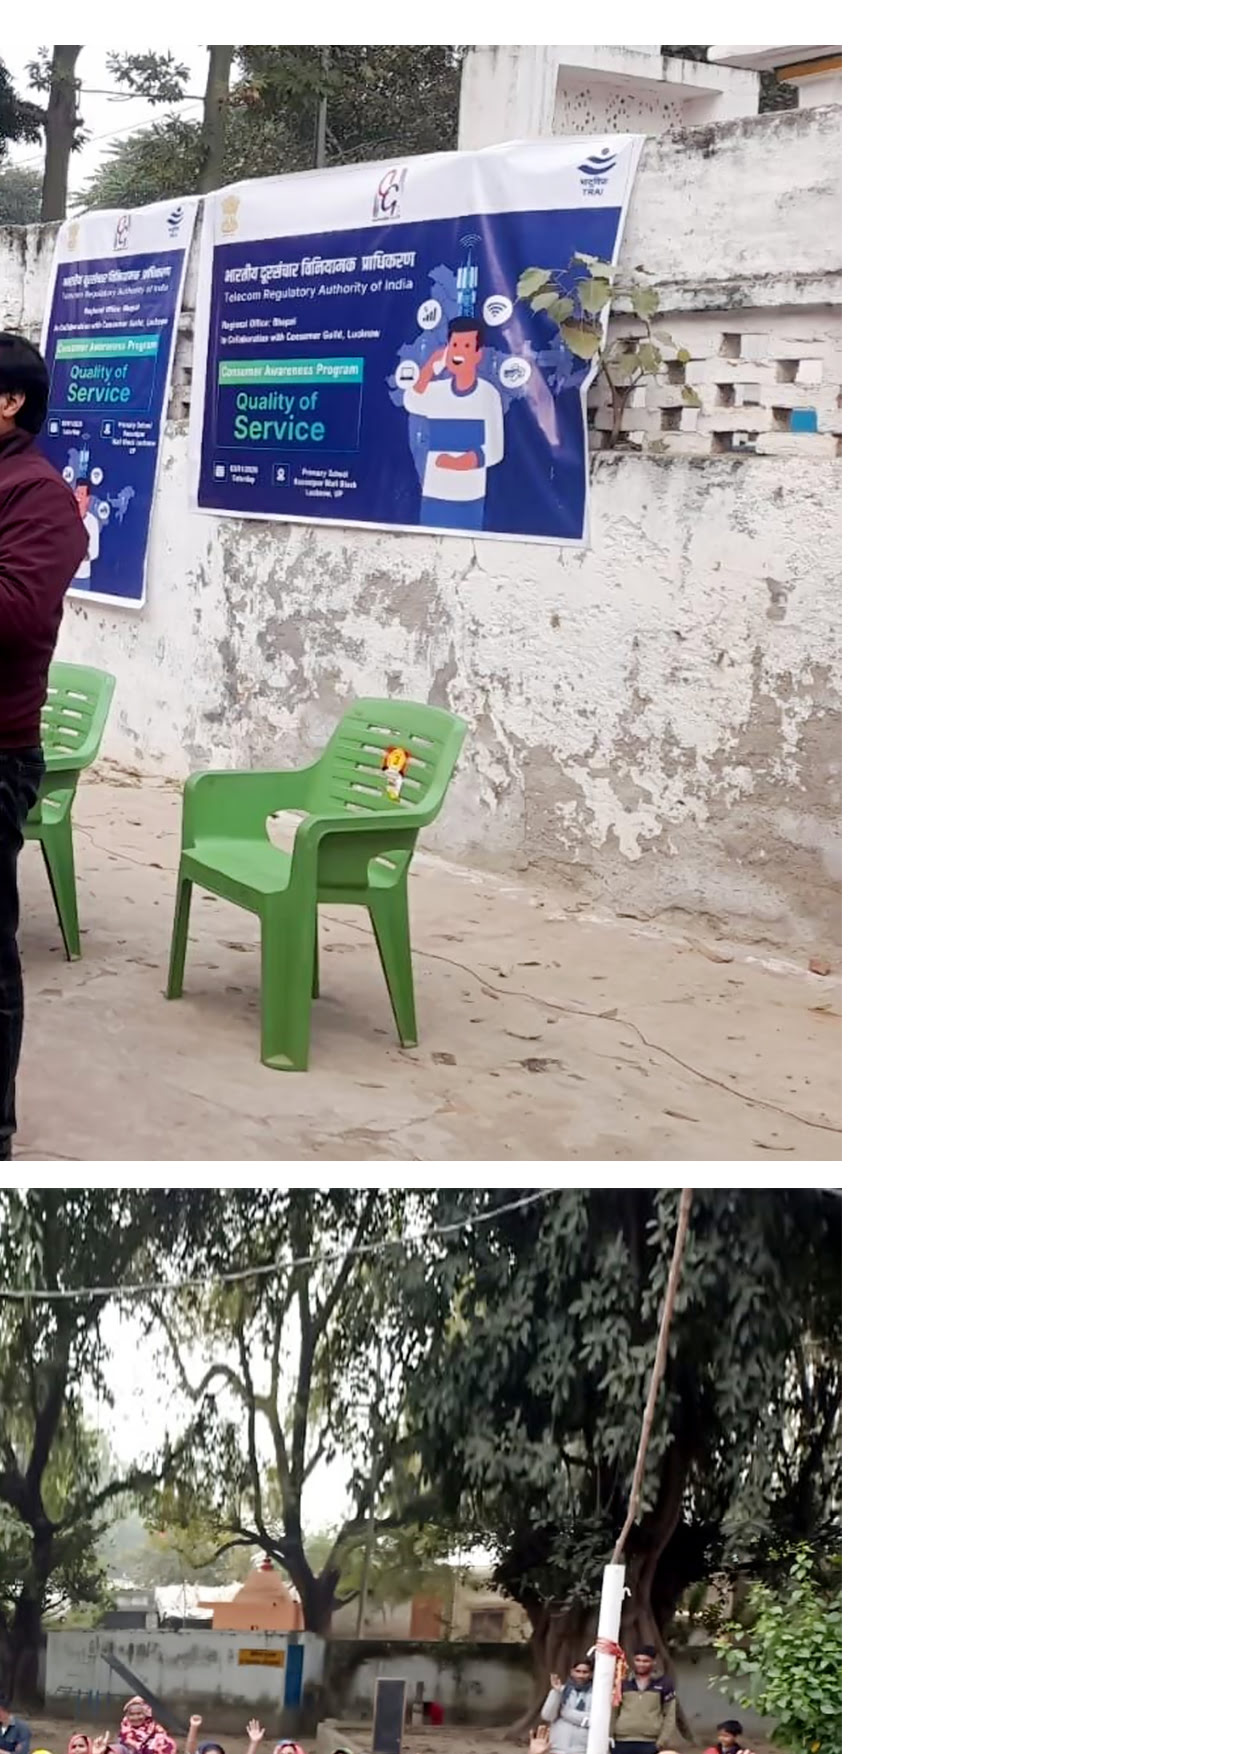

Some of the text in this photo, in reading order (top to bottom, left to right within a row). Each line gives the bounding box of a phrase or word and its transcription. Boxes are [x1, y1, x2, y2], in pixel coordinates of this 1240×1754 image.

[224, 250, 416, 285] भारतीय दूरसंचार विनियामक प्राधिकरण
[224, 278, 414, 303] Telecom Regulatory Authority of India
[286, 331, 321, 341] Consumer
[347, 328, 380, 339] Lucknow
[70, 363, 128, 382] Quality of
[221, 361, 359, 378] Consumer Awareness Program
[67, 381, 131, 403] Service
[236, 391, 319, 414] Quality of
[234, 414, 326, 441] Service
